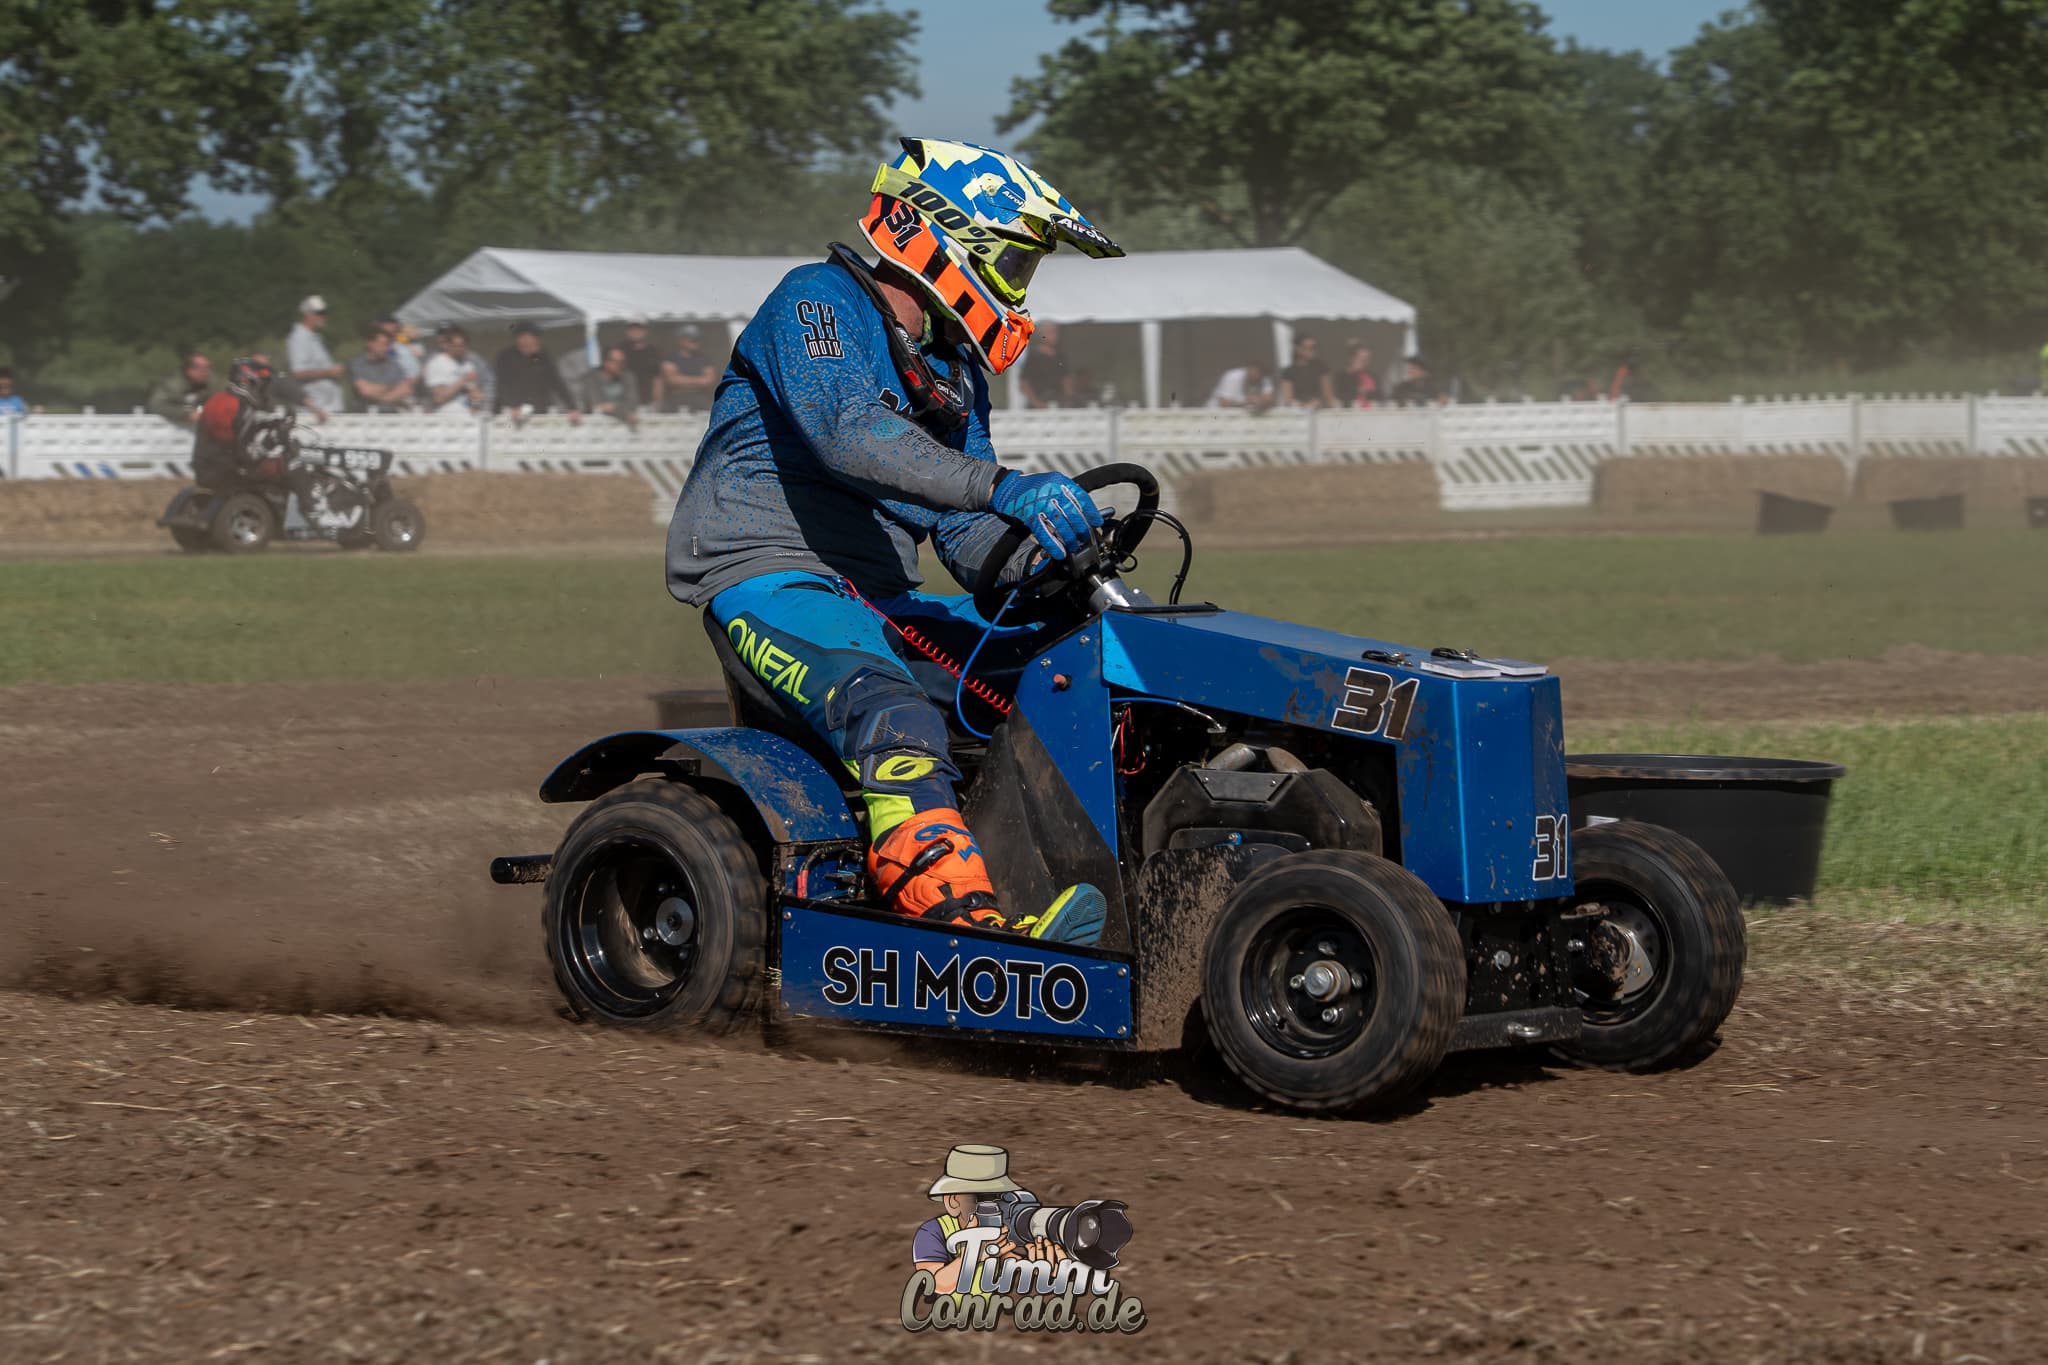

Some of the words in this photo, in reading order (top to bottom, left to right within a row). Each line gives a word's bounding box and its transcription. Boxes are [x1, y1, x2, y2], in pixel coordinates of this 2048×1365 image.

[884, 201, 924, 247] 31
[899, 181, 1000, 255] 100%
[796, 299, 839, 341] SH
[808, 340, 842, 357] MOTO
[1331, 666, 1420, 740] 31
[1532, 813, 1567, 881] 31
[822, 946, 899, 1008] SH
[914, 950, 1089, 1024] MOTO
